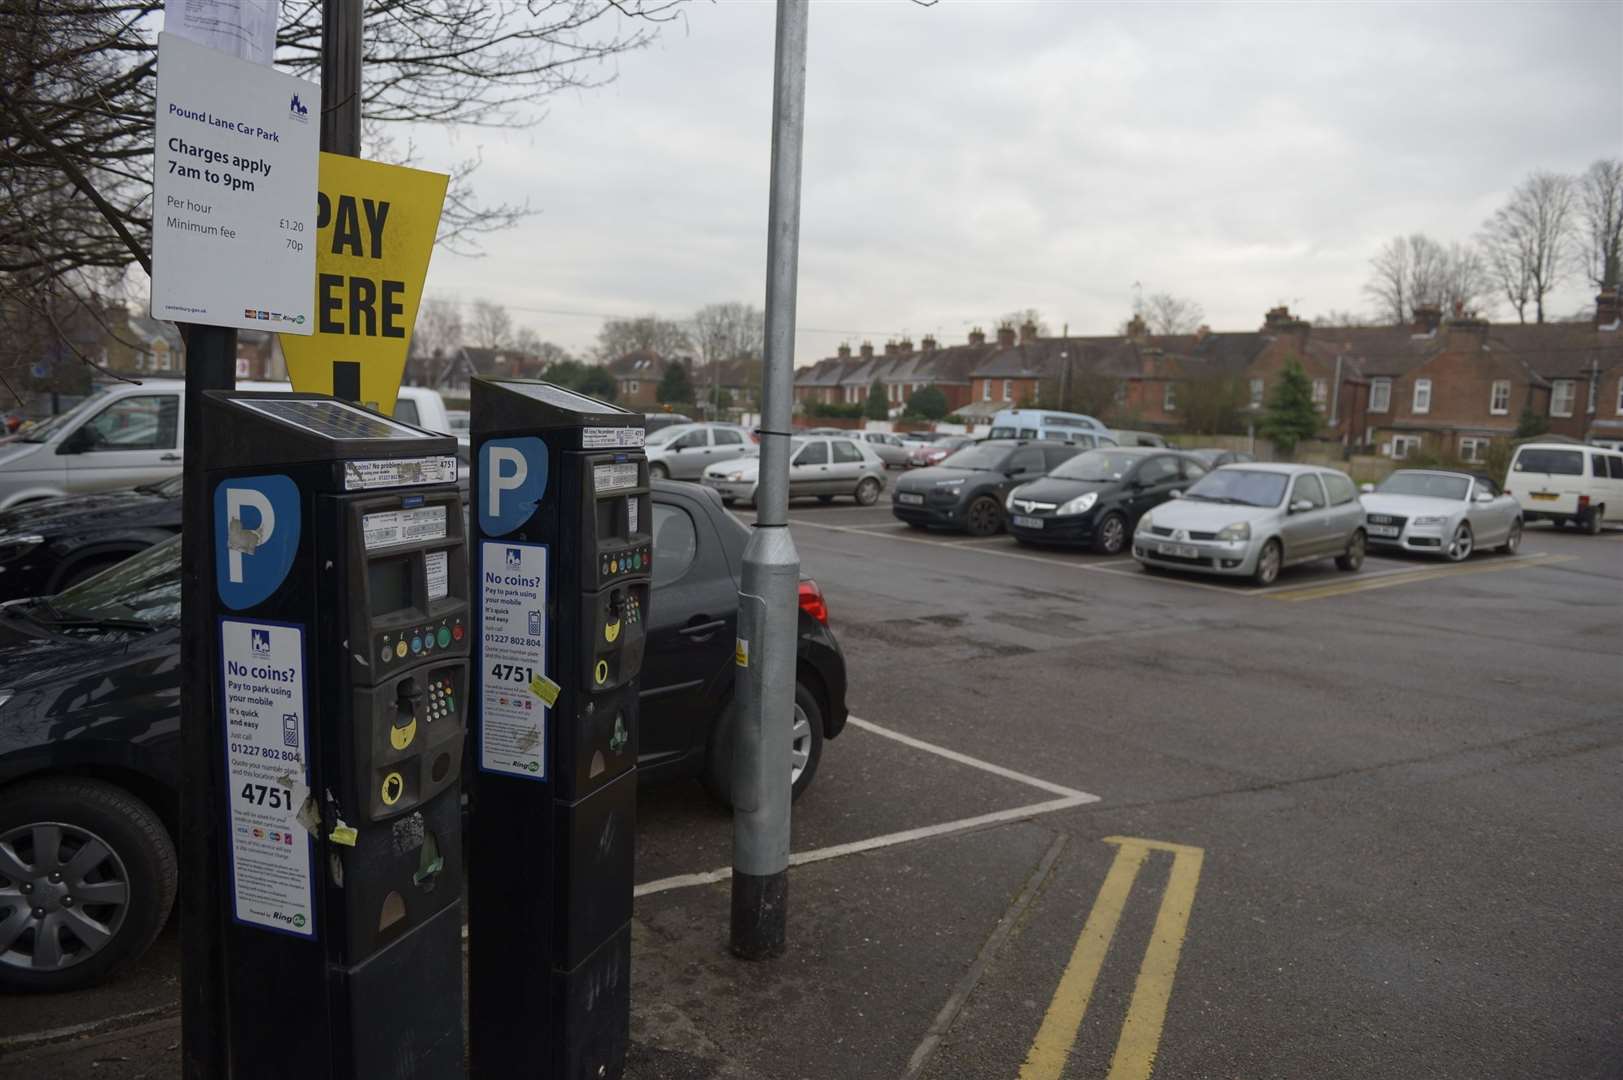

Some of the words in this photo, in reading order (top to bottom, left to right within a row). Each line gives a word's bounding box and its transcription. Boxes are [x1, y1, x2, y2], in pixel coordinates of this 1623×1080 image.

[169, 104, 206, 123] Pound
[208, 114, 235, 131] Lane
[237, 123, 254, 137] Car
[257, 128, 279, 143] Park
[168, 138, 229, 164] Charges
[232, 159, 272, 177] apply
[168, 160, 201, 180] 7am
[205, 169, 220, 184] to
[223, 173, 255, 191] 9pm
[167, 196, 185, 209] Per
[187, 200, 212, 214] hour
[166, 217, 218, 236] Minimum
[220, 226, 236, 239] fee
[279, 218, 304, 232] £1.20
[286, 238, 304, 252] 70p
[319, 273, 405, 338] ERE
[489, 446, 528, 517] P
[226, 488, 275, 583] P
[485, 572, 502, 584] No
[505, 574, 541, 588] coins?
[485, 633, 509, 643] 01227
[510, 636, 525, 646] 802
[526, 639, 541, 648] 804
[228, 660, 248, 677] No
[251, 665, 296, 683] coins?
[491, 663, 533, 684] 4751
[229, 680, 241, 691] Pay
[252, 684, 270, 693] park
[271, 686, 292, 698] using
[229, 695, 246, 703] your
[248, 697, 273, 706] mobile
[231, 743, 260, 756] 01227
[262, 747, 280, 760] 802
[281, 751, 301, 763] 804
[241, 783, 292, 811] 4751
